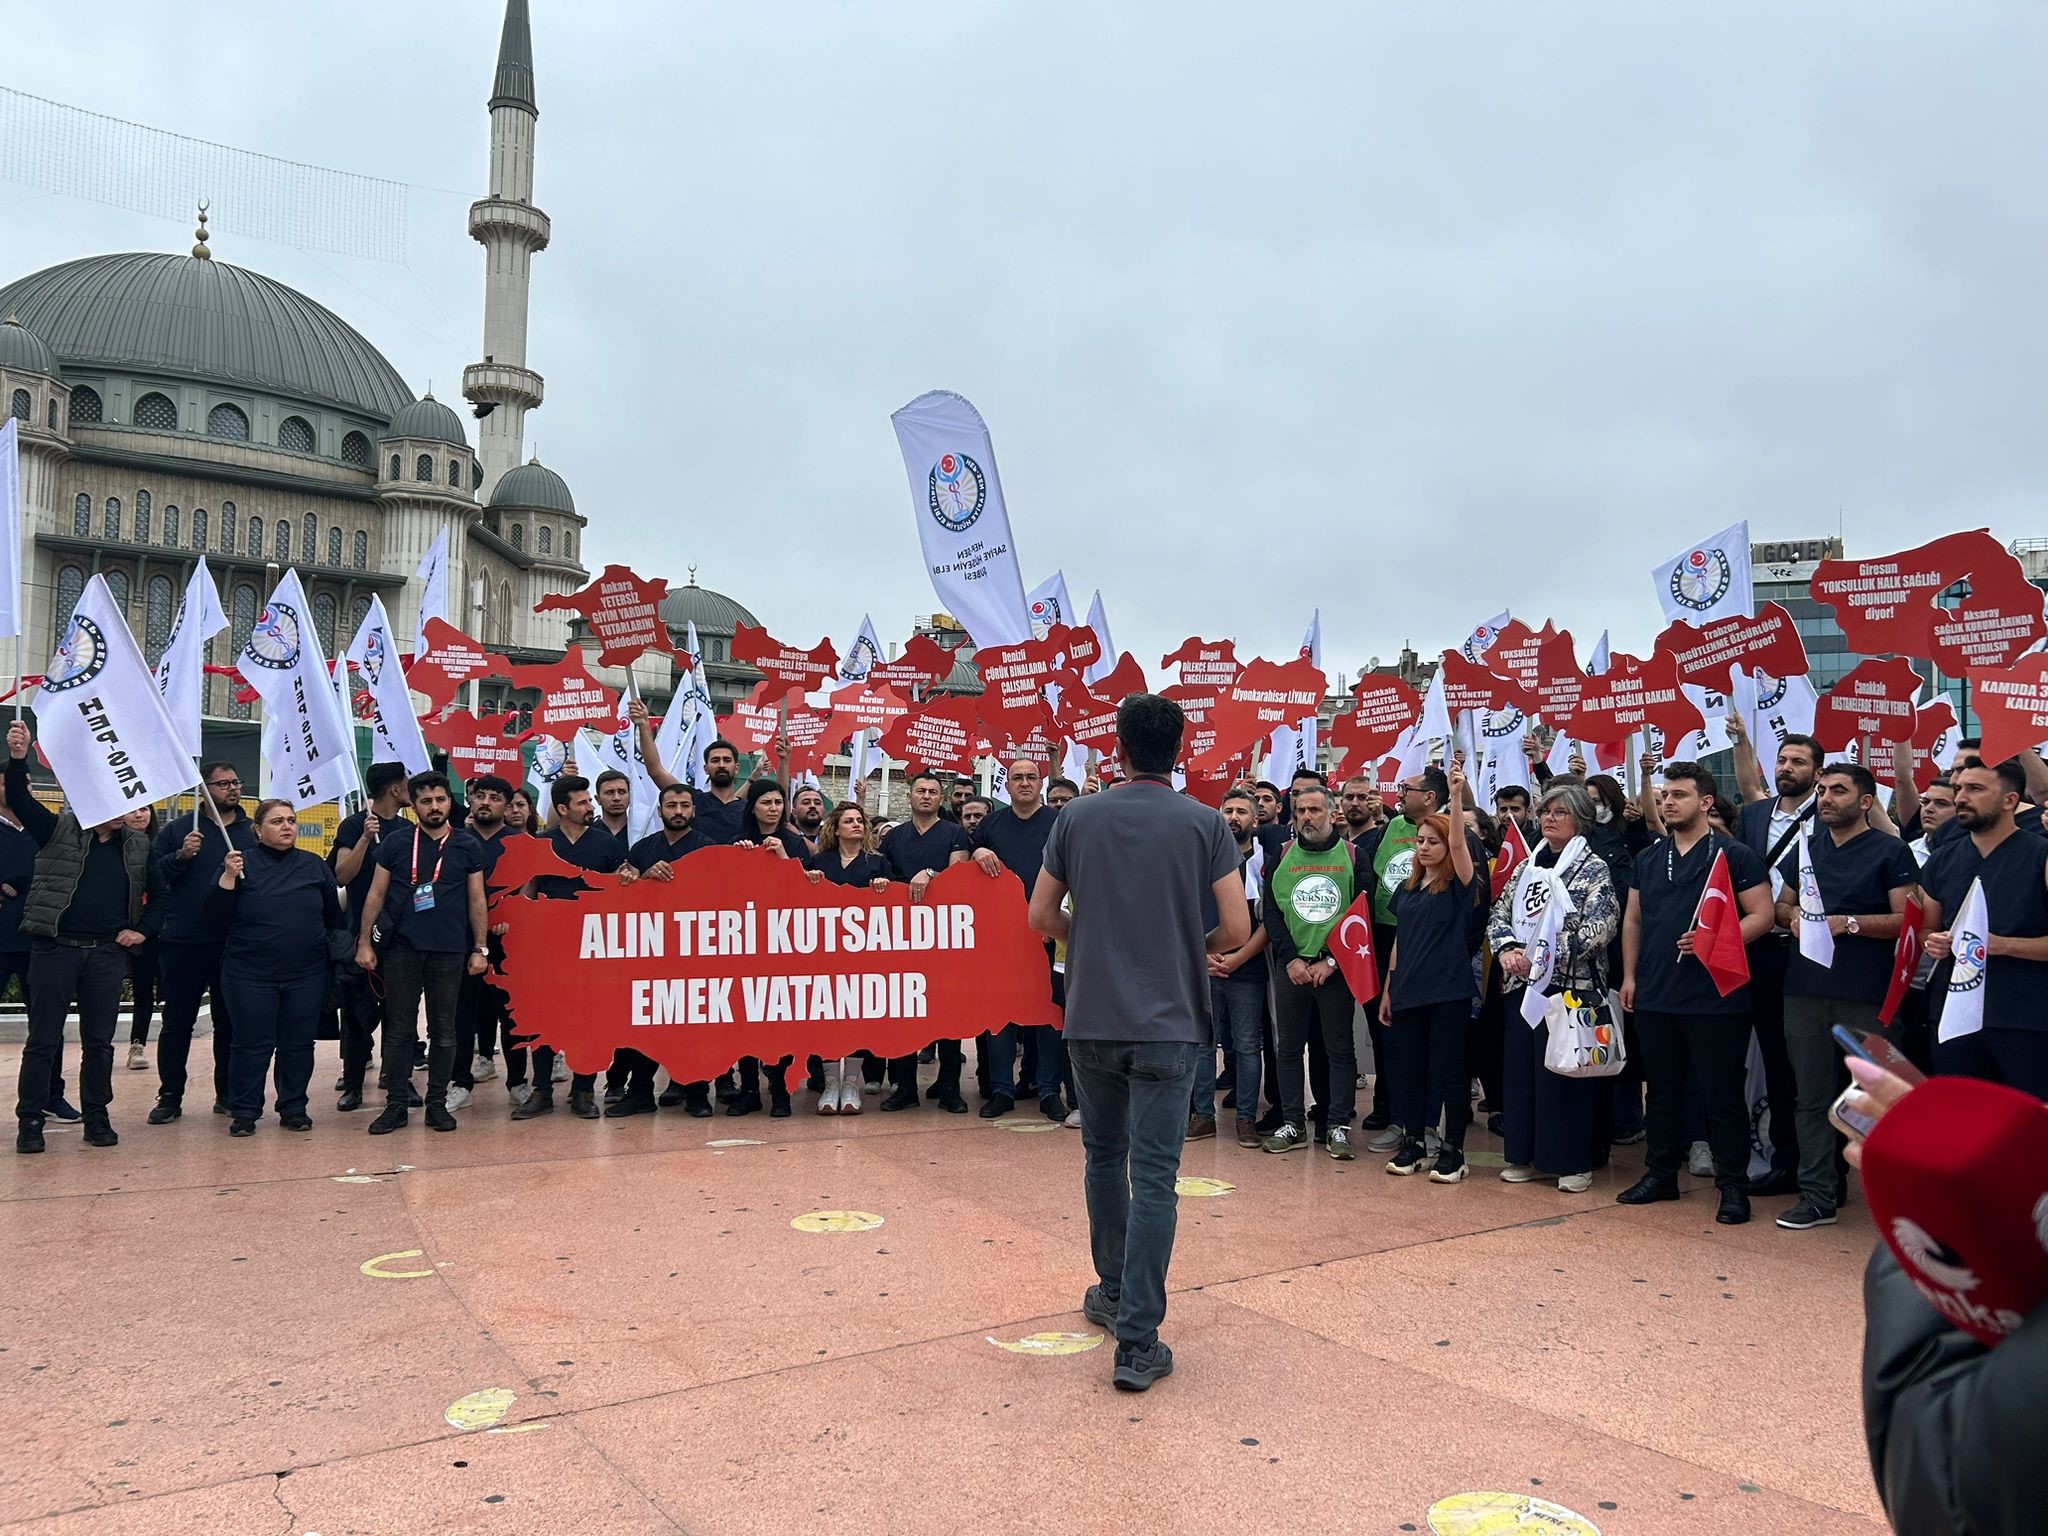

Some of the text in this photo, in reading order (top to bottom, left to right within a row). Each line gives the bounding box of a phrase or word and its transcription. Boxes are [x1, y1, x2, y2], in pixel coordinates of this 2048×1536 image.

[1859, 563, 1898, 576] Giresun
[601, 580, 633, 594] Ankara
[1877, 575, 1901, 589] HALK
[1902, 570, 1941, 587] SAĞLIĞI
[600, 592, 640, 608] YETERSİZ
[592, 604, 655, 624] GİYİM YARDIMI
[1865, 606, 1894, 621] diyor!
[1963, 608, 2000, 621] Aksaray
[599, 617, 655, 637] TUTARLARINI
[1702, 621, 1740, 641] Trabzon
[1729, 616, 1782, 644] ÖZGÜRLÜĞÜ
[1934, 614, 2035, 636] SAĞLIK KURUMLARINDA
[605, 632, 657, 650] reddediyor!
[1523, 637, 1542, 647] Ordu
[1748, 633, 1776, 651] diyor!
[1939, 627, 2031, 647] GÜVENLİK TEDBİRLERİ
[780, 649, 808, 661] Amasya
[1069, 641, 1094, 660] İzmir
[1499, 648, 1539, 659] YOKSULLU
[1961, 641, 2009, 656] ARTIRILSIN
[1002, 649, 1026, 664] Denizli
[1507, 658, 1538, 669] ÜZERİND
[1970, 654, 2003, 667] istiyor!
[756, 657, 830, 673] GÜVENCELİ İSTİHDAM
[1521, 668, 1539, 677] MAA
[779, 670, 806, 681] istiyor!
[985, 665, 1009, 683] ÇÜRÜK
[563, 677, 585, 691] Sinop
[1001, 678, 1036, 696] ÇALIŞMAK
[1554, 686, 1562, 694] VE
[1562, 685, 1582, 693] YARDI
[1610, 678, 1643, 693] Hakkari
[1854, 679, 1886, 696] Çanakkale
[1980, 680, 2037, 697] KAMUDA
[547, 688, 604, 707] SAĞLIKÇI EVLERİ
[859, 696, 885, 704] Burdur
[1002, 692, 1038, 709] istemiyor!
[1231, 687, 1317, 705] Afyonkarahisar LİYAKAT
[1362, 687, 1396, 699] Kırıkkale
[1457, 690, 1492, 698] YÖNETİM
[1582, 697, 1600, 712] ADİL
[1600, 694, 1615, 710] BİR
[1615, 691, 1644, 708] SAĞLIK
[1645, 688, 1676, 705] BAKANI
[834, 703, 908, 714] MEMURA GREV HAKKI
[1177, 697, 1215, 709] stamonu
[1363, 694, 1399, 708] ADALETSİZ
[1460, 699, 1490, 707] istiyor!
[1873, 698, 1890, 715] TEMİZ
[2005, 697, 2048, 712] KALDI
[543, 704, 611, 725] AÇILMASINI istiyor!
[1257, 707, 1285, 722] istiyor!
[1357, 702, 1408, 718] KAT SAYILARIN
[1555, 712, 1572, 721] istiyo
[1614, 708, 1645, 724] istiyor!
[857, 715, 884, 724] istiyor!
[919, 713, 960, 728] Zonguldak
[1073, 711, 1117, 731] EMEK SERMAYE
[1356, 709, 1412, 727] DÜZELTİLMESİNİ
[1858, 716, 1880, 732] istiyor!
[943, 727, 966, 737] KAMU
[1074, 725, 1107, 741] SATILAMAZ
[1196, 730, 1217, 739] Osma
[1372, 722, 1398, 733] istiyor!
[906, 728, 967, 747] ÇALIŞANLARININ
[917, 739, 953, 752] ŞARTLARI
[920, 757, 944, 767] diyor!
[1033, 753, 1050, 762] ARTS
[1288, 865, 1345, 873] INFERMIERE
[578, 901, 975, 960] ALIN TERİ KUTSALDIR
[631, 972, 927, 1027] EMEK VATANDIR
